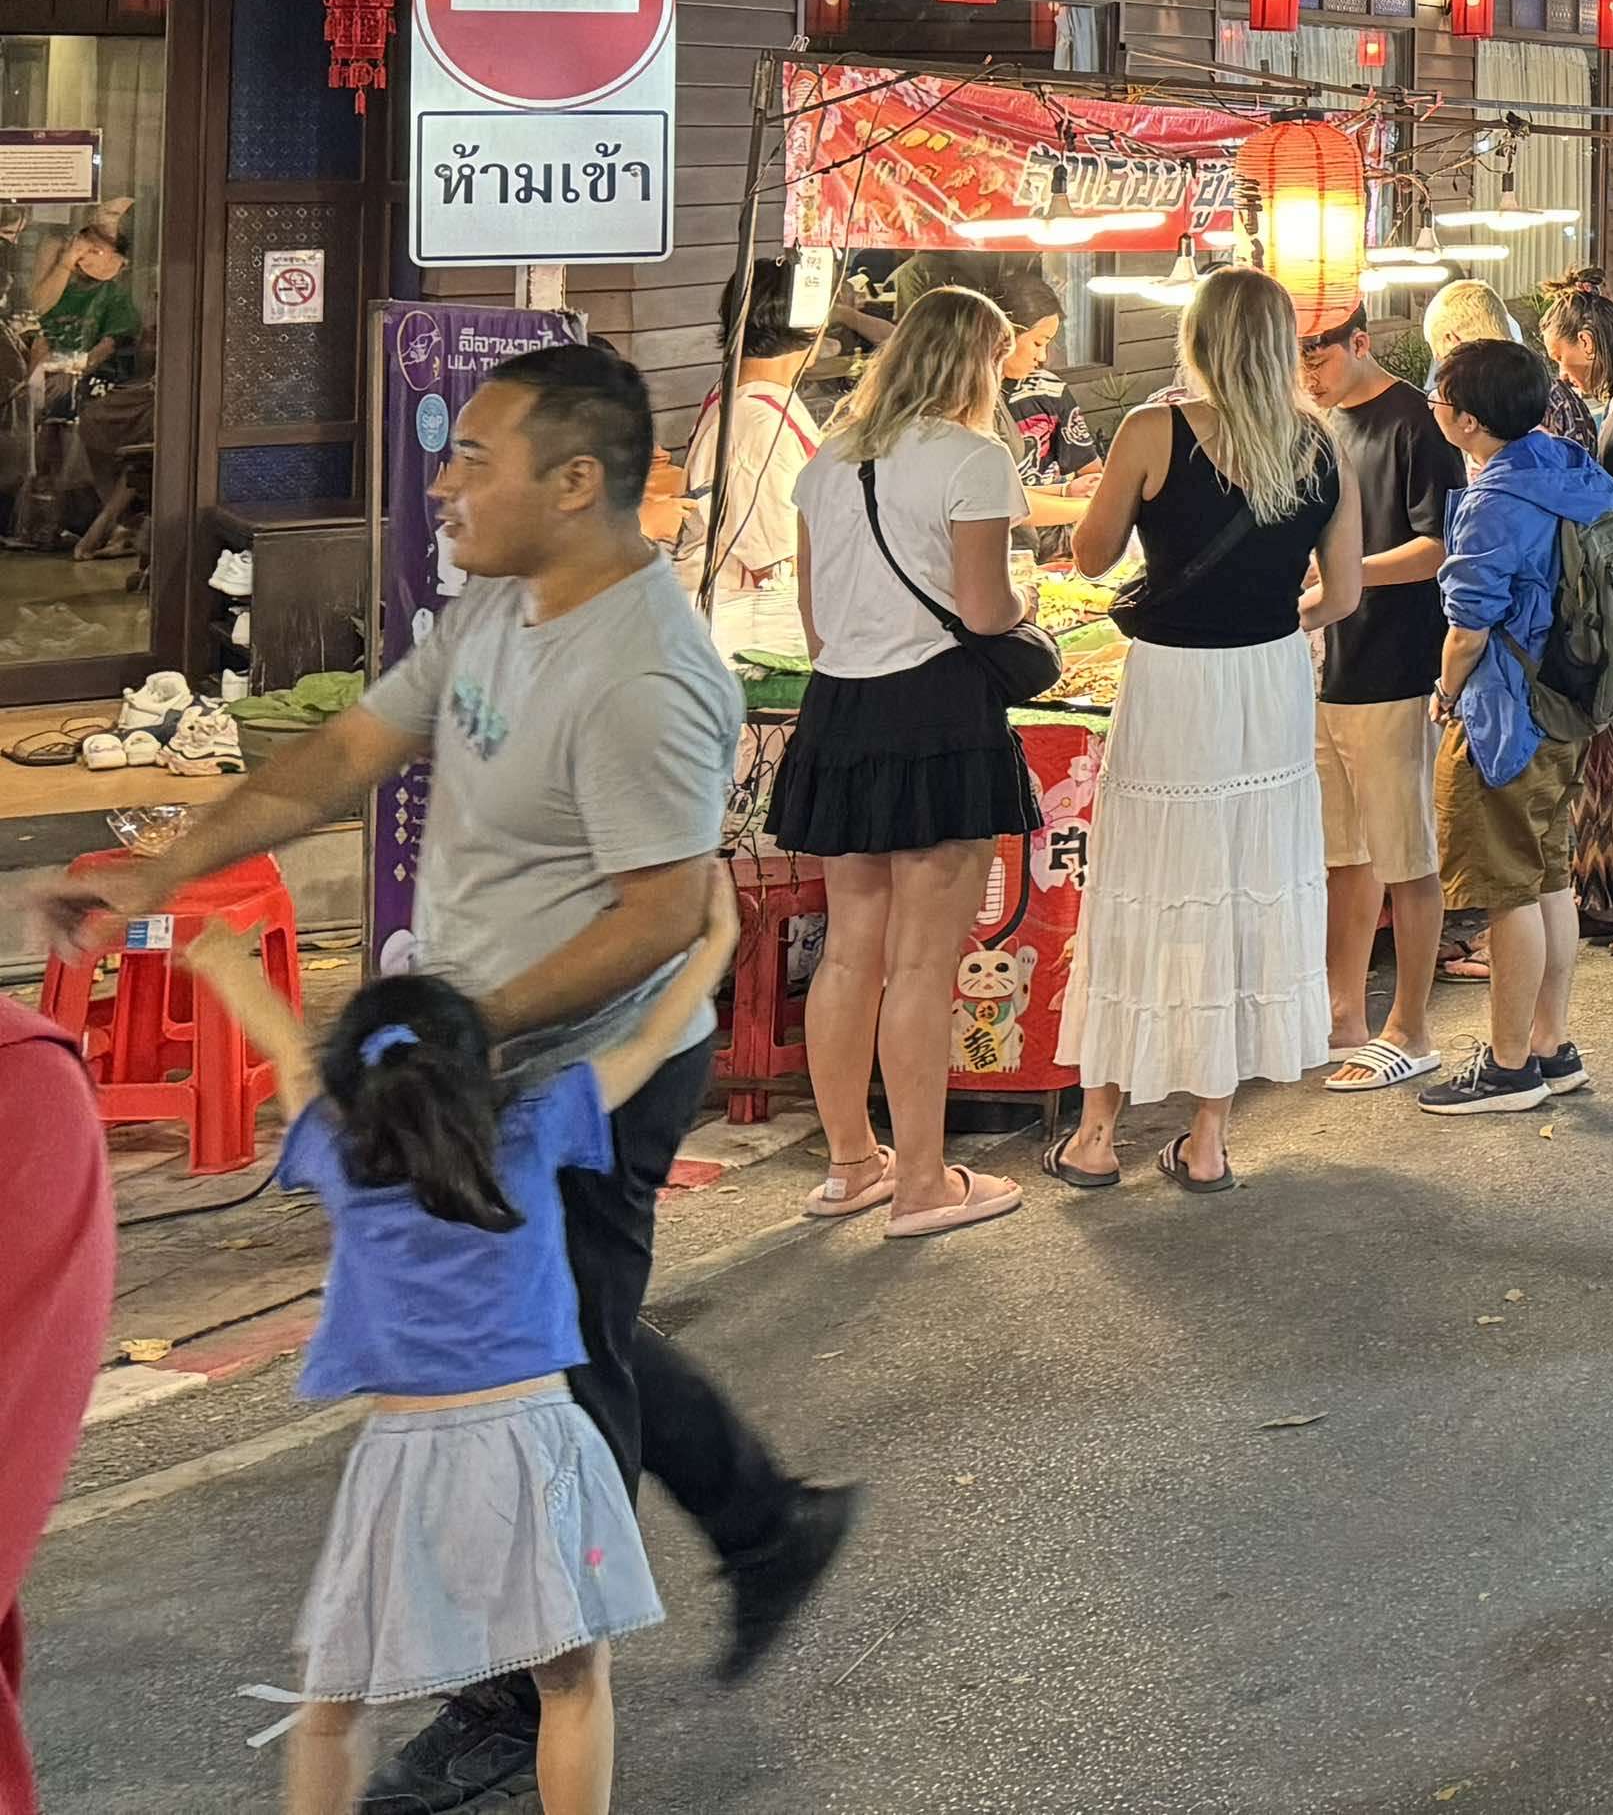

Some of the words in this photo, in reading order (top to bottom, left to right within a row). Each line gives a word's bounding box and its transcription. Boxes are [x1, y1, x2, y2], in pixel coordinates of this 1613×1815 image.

[434, 142, 650, 205] ห้ามเข้า
[448, 354, 477, 372] LILA
